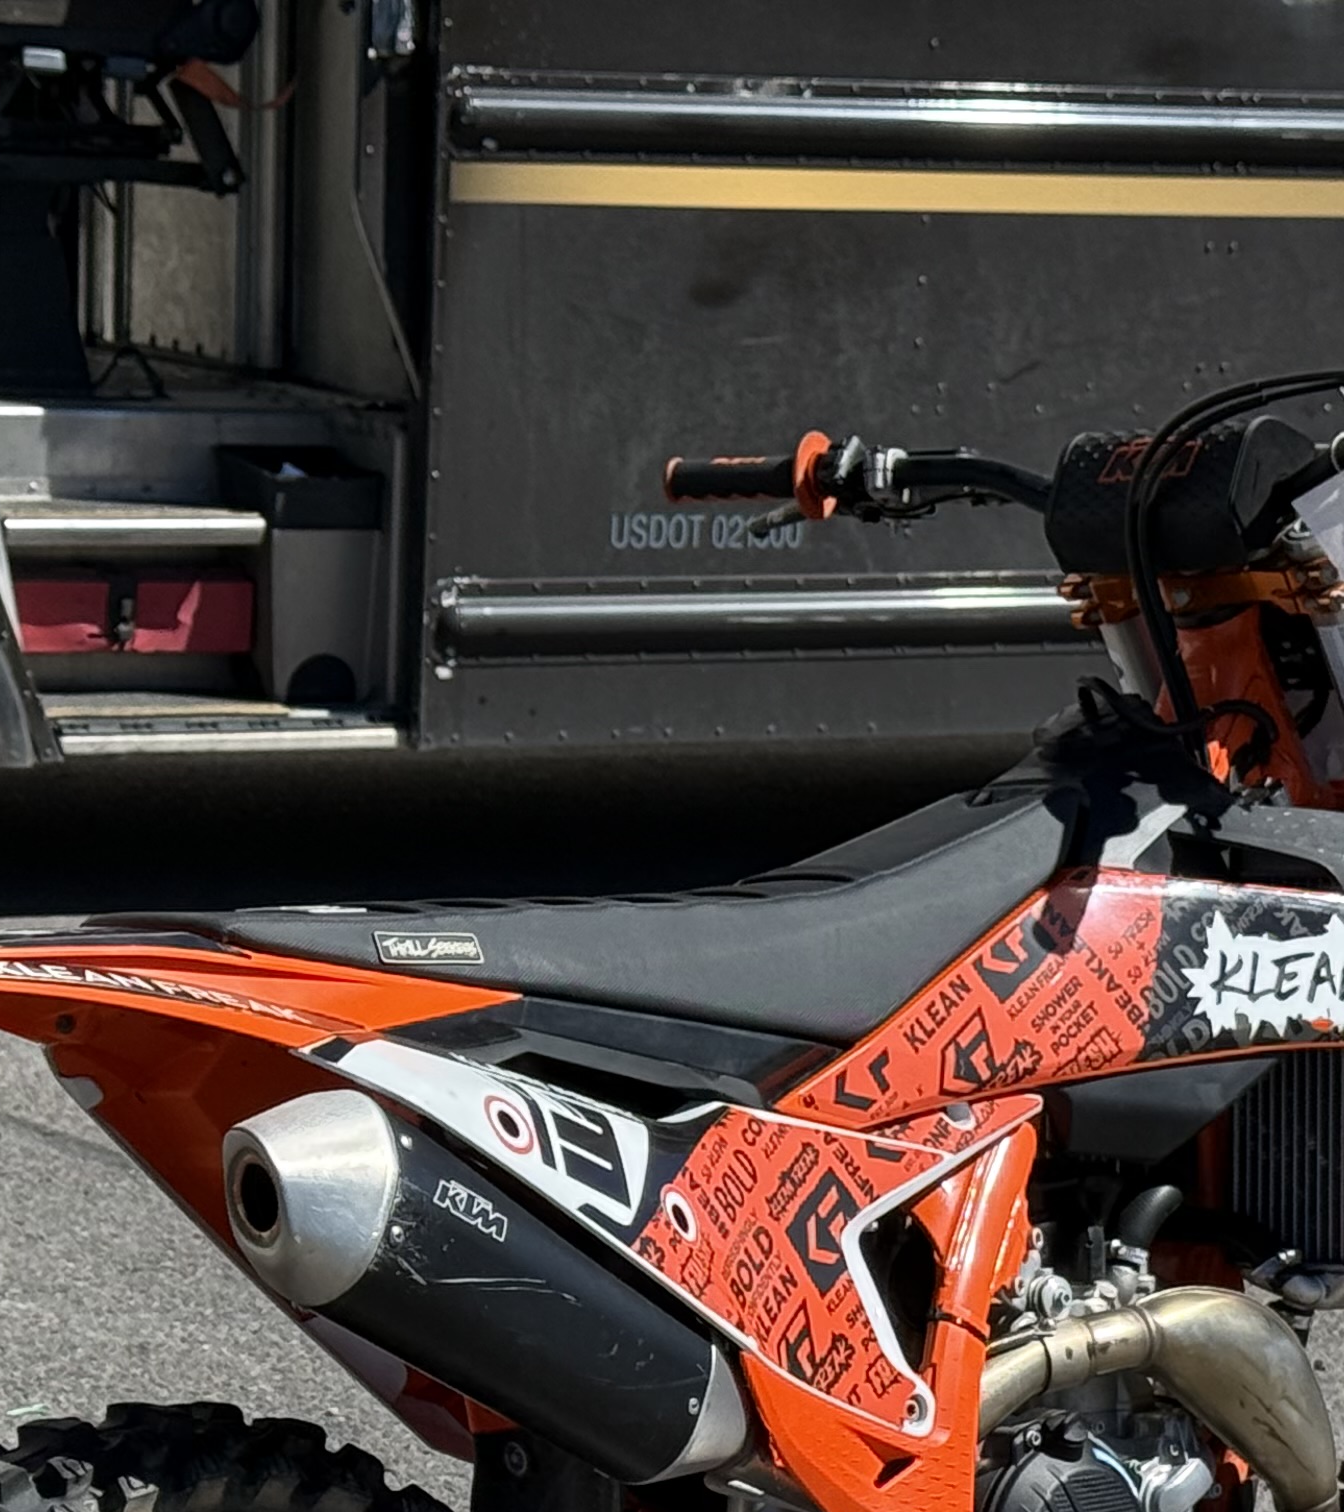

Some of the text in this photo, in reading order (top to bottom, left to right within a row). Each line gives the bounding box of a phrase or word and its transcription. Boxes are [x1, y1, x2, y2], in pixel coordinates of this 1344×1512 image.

[610, 514, 704, 549] USDOT
[150, 979, 312, 1024] FREAK
[903, 974, 972, 1053] KLEAN
[1031, 975, 1084, 1034] SHOWER
[1049, 1002, 1100, 1057] POCKET
[433, 1179, 507, 1243] KTM
[714, 1149, 758, 1223] BOLD
[729, 1226, 773, 1311] BOLD
